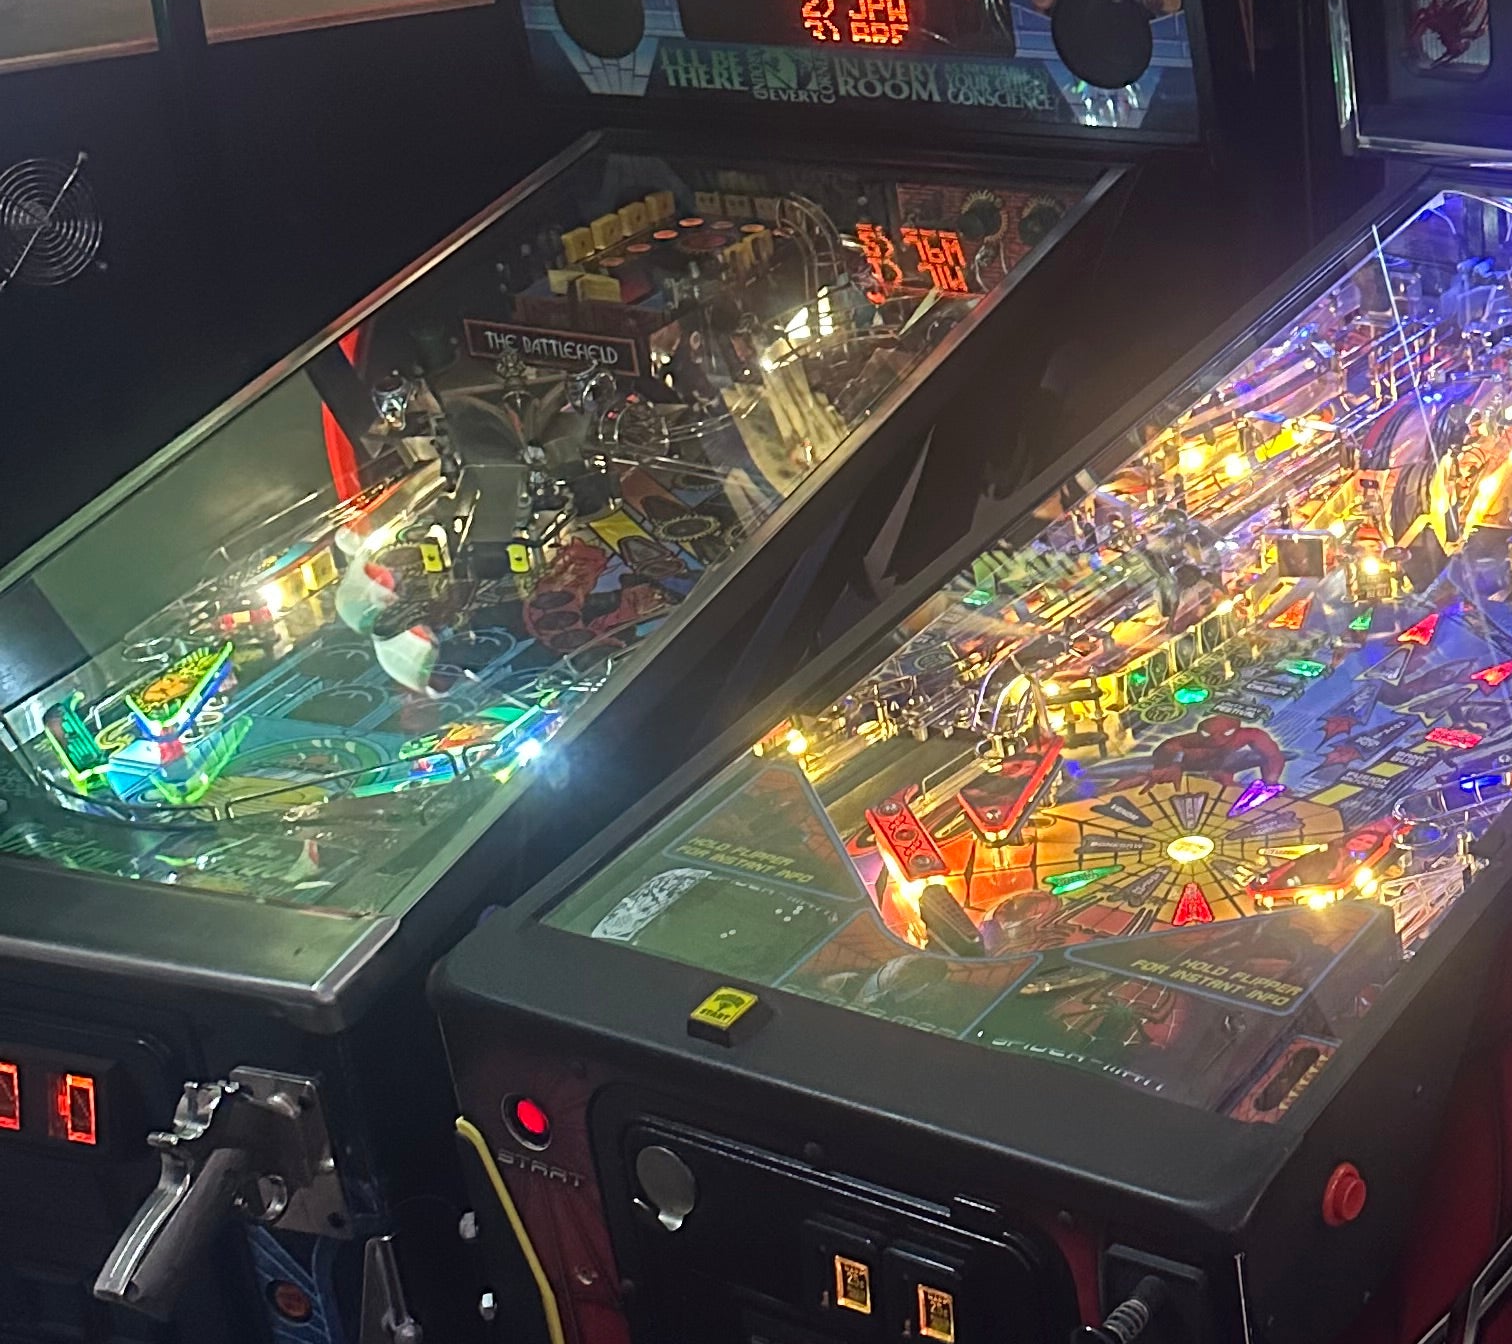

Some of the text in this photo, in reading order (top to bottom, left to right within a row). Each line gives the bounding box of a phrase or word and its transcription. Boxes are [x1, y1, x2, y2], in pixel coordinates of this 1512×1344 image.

[661, 64, 749, 91] THERE
[834, 55, 938, 82] IN EVERY
[769, 89, 820, 104] EVERY
[837, 77, 942, 103] ROOM
[484, 331, 619, 366] THE BATTLEFIELD
[1131, 958, 1291, 1008] FOR INSTANT INFO
[1179, 957, 1305, 997] HOLD FLIPPER
[498, 1153, 587, 1189] START
